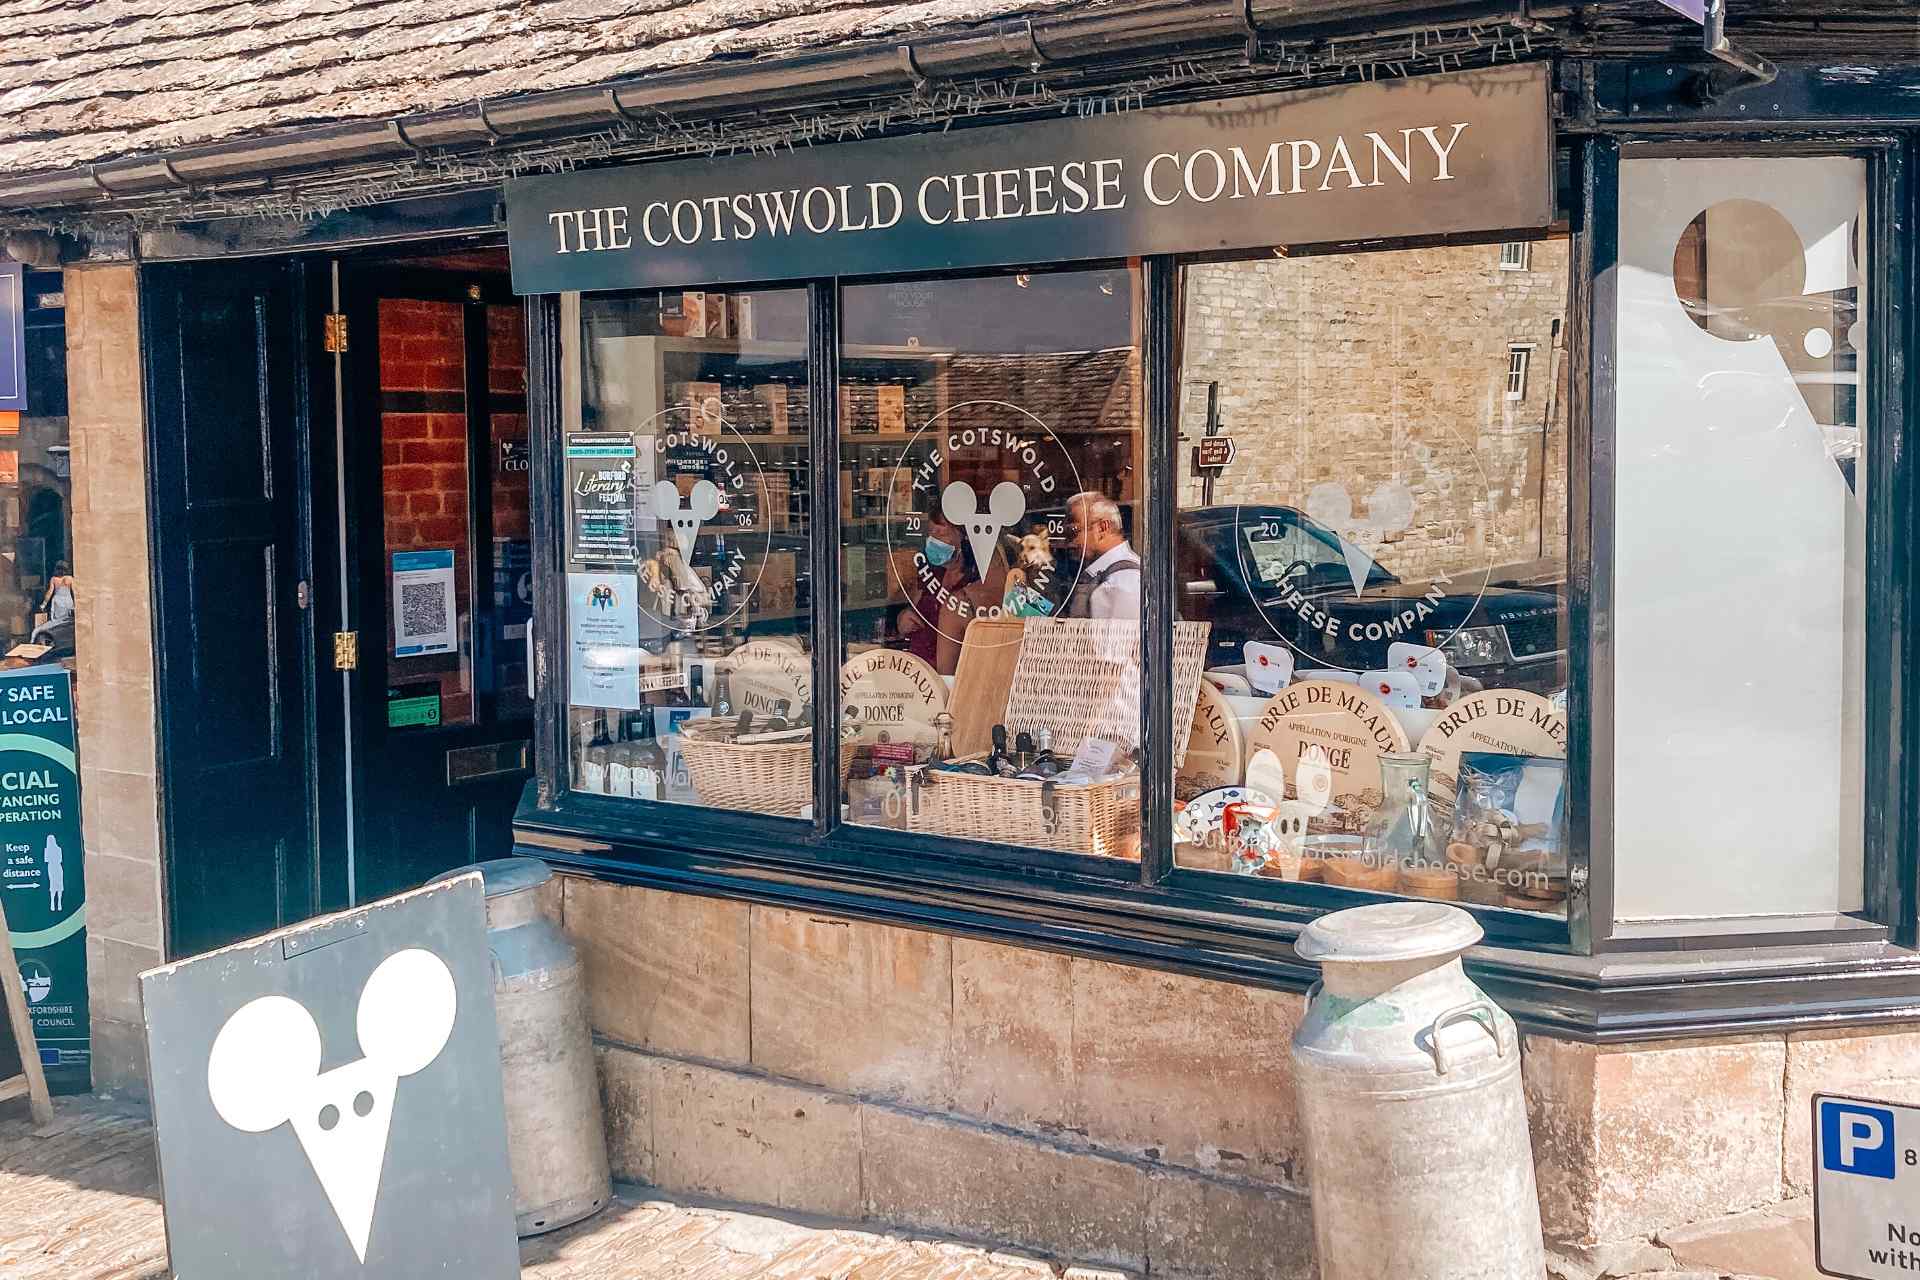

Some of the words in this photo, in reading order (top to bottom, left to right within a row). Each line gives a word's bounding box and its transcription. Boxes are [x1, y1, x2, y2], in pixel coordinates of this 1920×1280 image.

[549, 205, 632, 254] THE
[641, 181, 903, 248] COTSWOLD
[917, 158, 1127, 226] CHEESE
[1143, 122, 1470, 207] COMPANY
[655, 431, 744, 489] COTSWOLD
[912, 449, 944, 493] THE
[948, 427, 1056, 493] COTSWOLD
[574, 472, 626, 496] Literary
[738, 514, 753, 527] 06
[905, 516, 921, 531] 20
[1048, 519, 1064, 534] 06
[1260, 522, 1279, 538] 20
[681, 547, 746, 607] CMPANY
[912, 552, 970, 618] CHEESE
[975, 560, 1056, 620] COMPANY
[1349, 569, 1453, 642] COMPANY
[866, 655, 885, 672] DE
[889, 655, 937, 705] MEAUX
[7, 685, 55, 702] SAFE
[1, 707, 68, 725] LOCAL
[1259, 690, 1302, 734] BRIE
[1306, 686, 1333, 704] DE
[1336, 690, 1397, 755] MEAUX
[1436, 699, 1488, 739] BRIE
[1495, 697, 1526, 718] DE
[1, 770, 59, 791] CIAL
[0, 793, 60, 808] ANCING
[6, 843, 30, 853] Keep
[15, 855, 34, 865] safe
[3, 869, 41, 878] distance
[37, 1018, 75, 1026] COUNCIL
[1839, 1111, 1884, 1167] P
